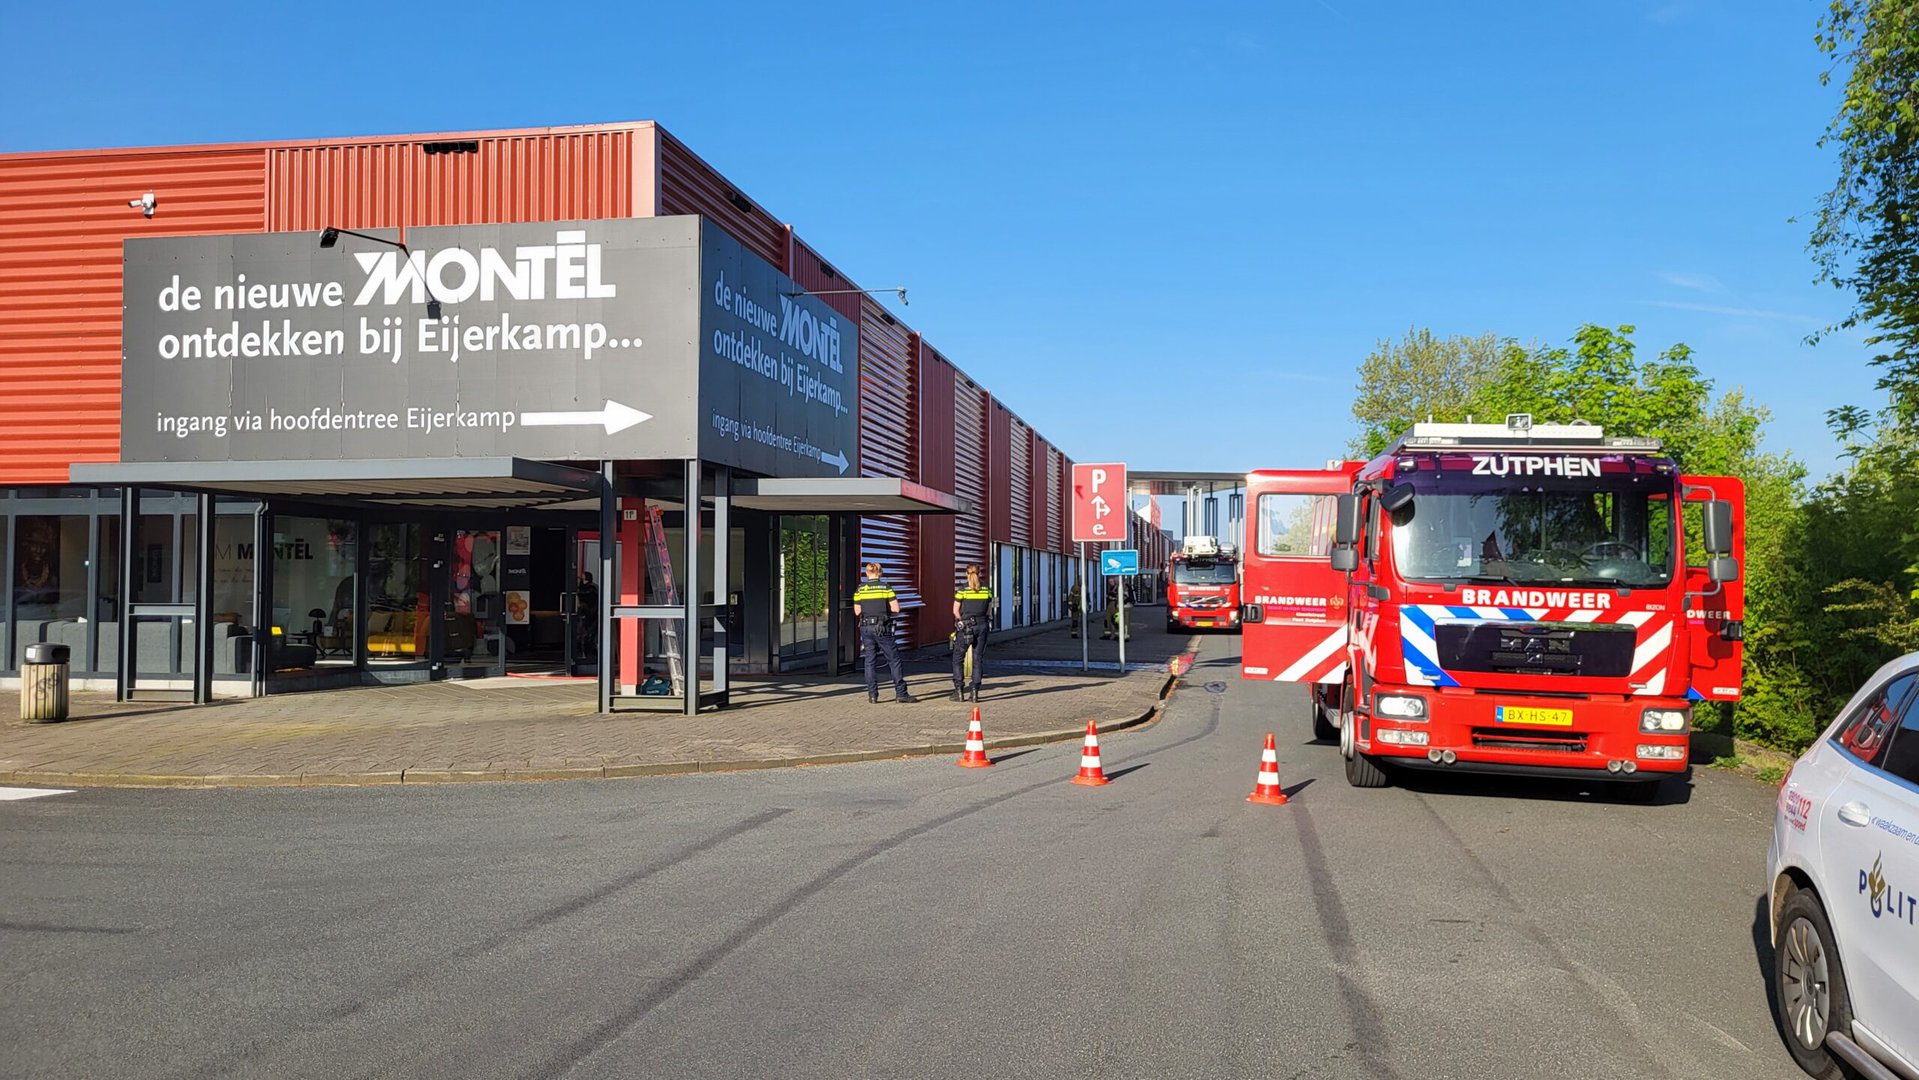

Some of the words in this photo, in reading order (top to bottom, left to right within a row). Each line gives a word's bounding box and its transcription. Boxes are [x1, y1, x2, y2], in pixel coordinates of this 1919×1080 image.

[158, 274, 202, 311] de
[214, 273, 343, 309] nieuwe
[714, 270, 731, 311] de
[734, 285, 777, 337] nieuwe
[158, 319, 344, 359] ontdekken
[359, 316, 403, 365] bij
[418, 312, 643, 364] Eijerkamp...
[714, 329, 778, 381] ontdekken
[780, 352, 794, 396] bij
[157, 410, 228, 438] ingang
[233, 409, 262, 431] via
[270, 407, 399, 430] hoofdentree
[407, 402, 516, 435] Eijerkamp
[712, 408, 740, 441] ingang
[740, 418, 751, 439] via
[753, 422, 792, 452] hoofdentree
[793, 435, 823, 462] Eijerkamp
[1091, 469, 1107, 493] P
[1472, 456, 1602, 477] ZUTPHEN
[1254, 595, 1327, 606] BRANDWEER
[1462, 589, 1611, 609] BRANDWEER
[1508, 709, 1567, 723] BX-HS-47
[1797, 798, 1811, 820] 112
